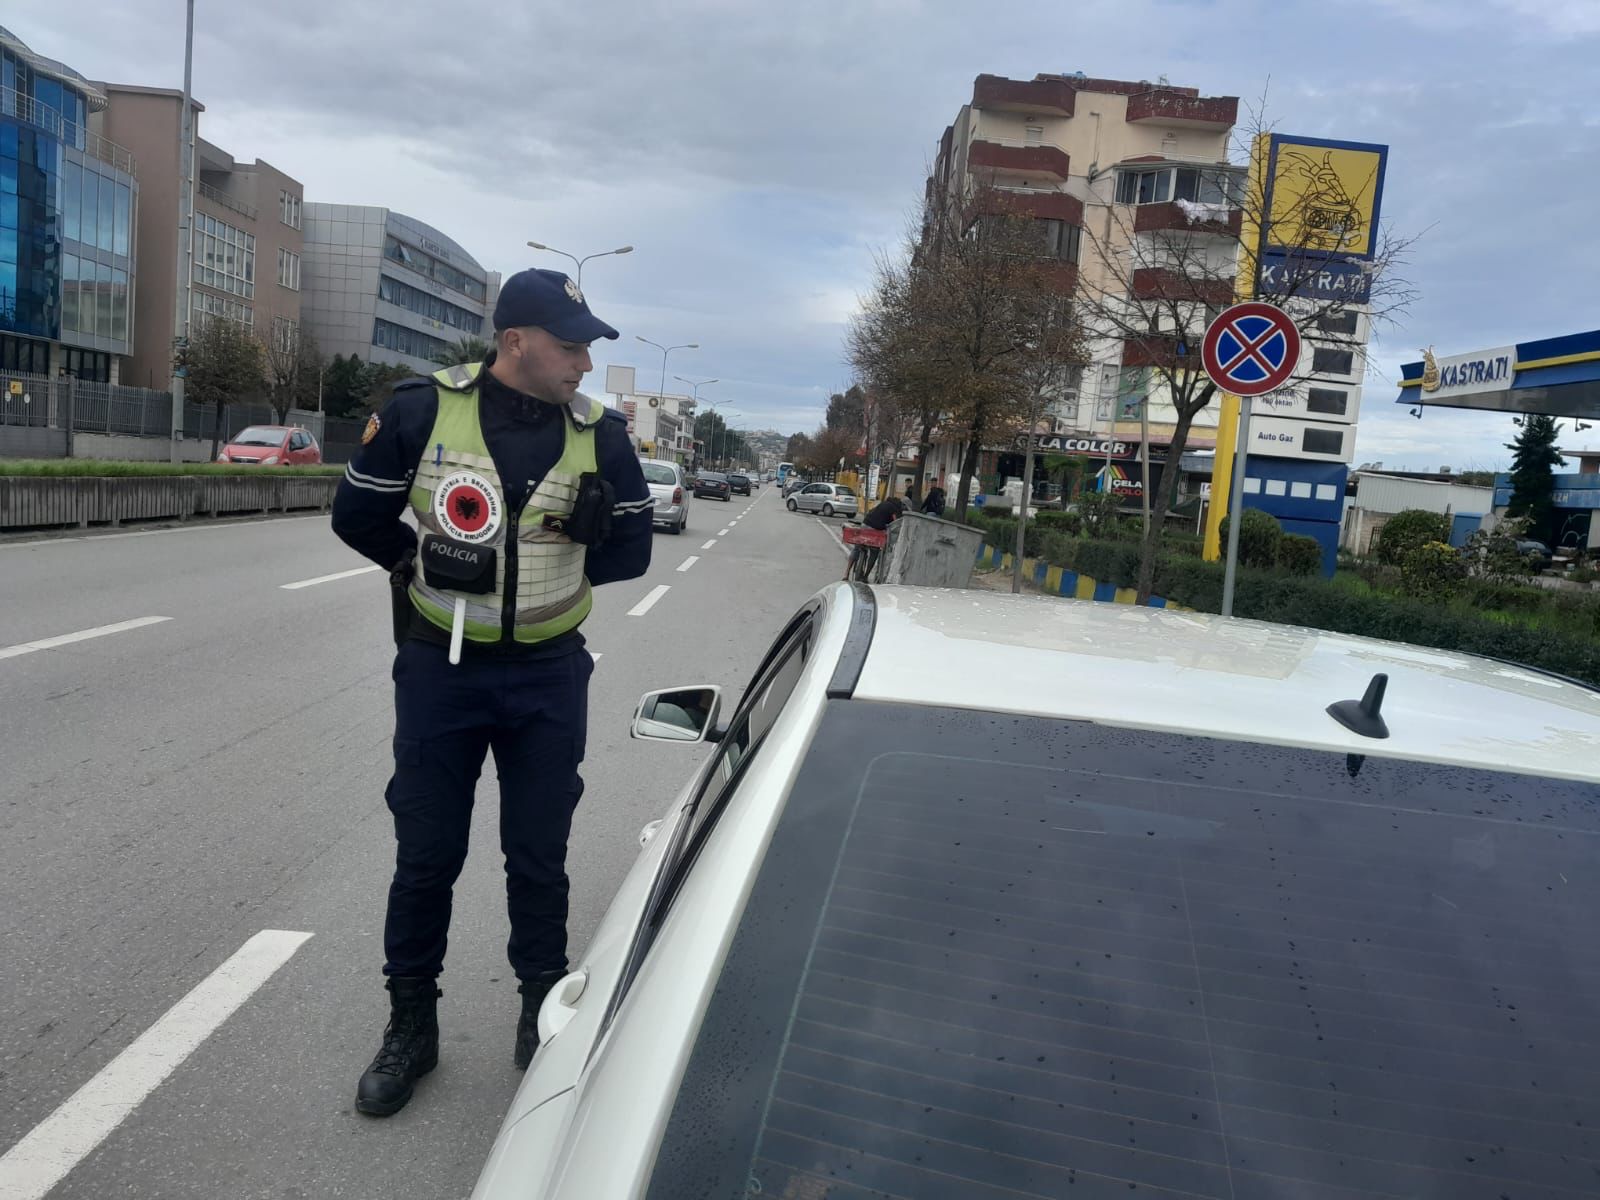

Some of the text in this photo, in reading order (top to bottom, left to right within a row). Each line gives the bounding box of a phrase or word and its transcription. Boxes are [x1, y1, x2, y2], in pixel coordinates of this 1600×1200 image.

[1440, 356, 1509, 387] KASTRATI
[1065, 439, 1127, 454] COLOR
[1258, 432, 1294, 443] Auto Gaz
[439, 478, 460, 507] MINISTRIA
[1112, 480, 1143, 489] ÇELA
[439, 513, 463, 538] POLICIA
[430, 541, 479, 564] POLICIA
